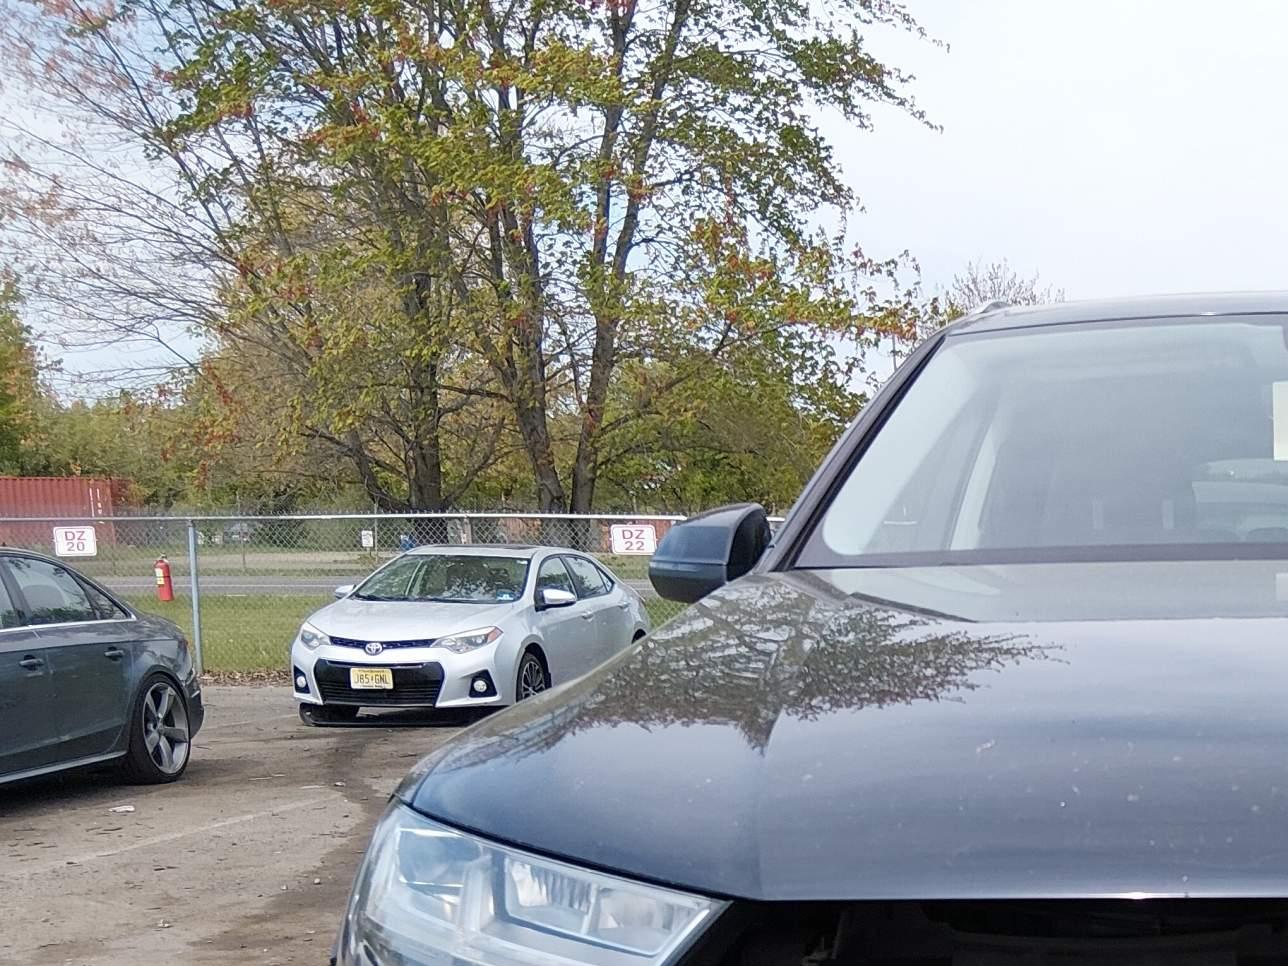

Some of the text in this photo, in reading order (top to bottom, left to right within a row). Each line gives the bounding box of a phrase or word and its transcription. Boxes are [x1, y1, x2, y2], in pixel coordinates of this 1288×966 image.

[64, 530, 87, 541] DZ
[622, 529, 646, 540] DZ
[66, 541, 86, 552] 20
[624, 540, 645, 551] 22
